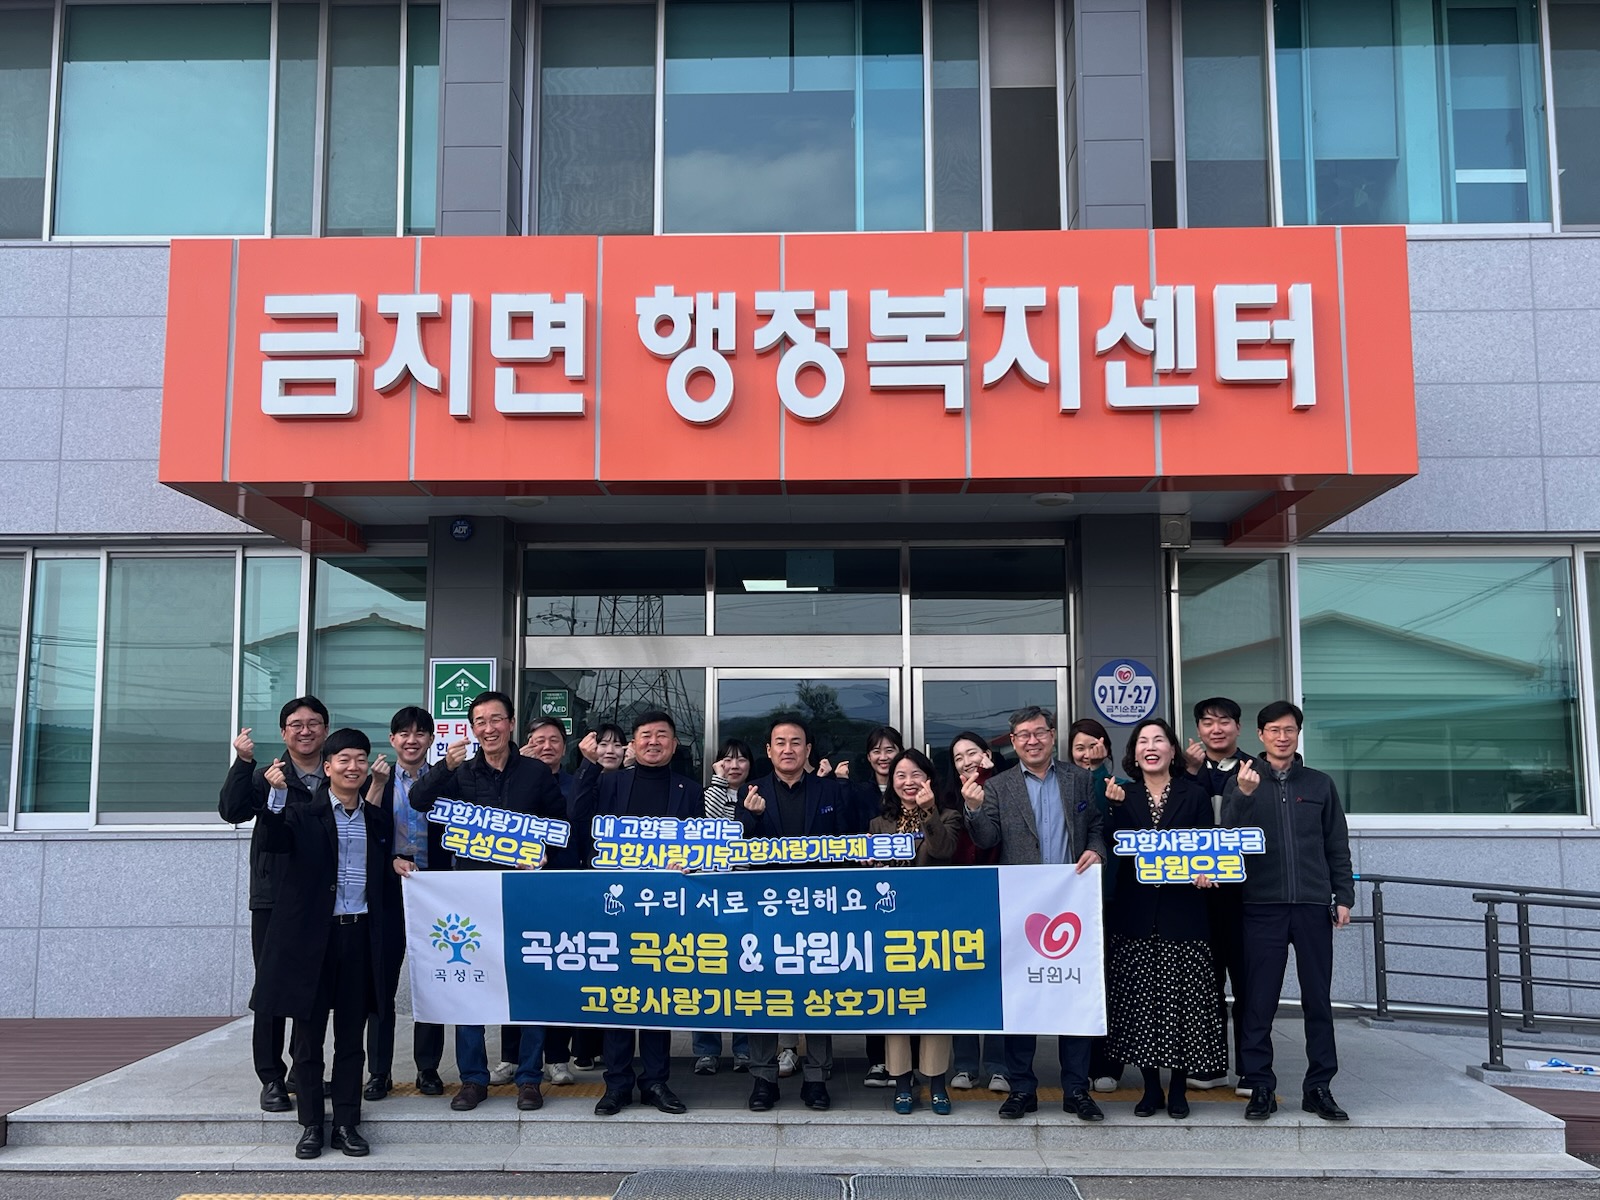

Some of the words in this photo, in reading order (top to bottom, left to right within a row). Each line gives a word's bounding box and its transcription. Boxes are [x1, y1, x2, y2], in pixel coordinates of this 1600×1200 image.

[259, 293, 587, 419] 금지면
[635, 284, 1318, 424] 행정복지센터
[453, 526, 468, 534] ADT
[1098, 685, 1152, 704] 917-27
[1106, 705, 1146, 713] 금지순환길
[430, 800, 568, 844] 고향사랑기부금
[595, 818, 614, 838] 내
[619, 819, 678, 840] 고향을
[683, 820, 742, 840] 살리는
[444, 826, 543, 867] 곡성으로
[728, 836, 868, 862] 고향사랑기부제
[872, 835, 913, 858] 응원
[1114, 829, 1264, 852] 고향사랑기부금
[1138, 856, 1243, 880] 남원으로
[634, 887, 686, 916] 우리
[696, 889, 749, 917] 서로
[757, 886, 867, 917] 응원해요
[521, 931, 620, 971] 곡성군
[630, 932, 728, 974] 곡성읍
[739, 933, 764, 973] &
[773, 930, 873, 975] 남원시
[884, 928, 985, 973] 금지면
[434, 969, 485, 983] 곡성군
[1027, 966, 1081, 984] 남원시
[580, 985, 794, 1017] 고향사랑기부금
[803, 987, 927, 1017] 상호기부
